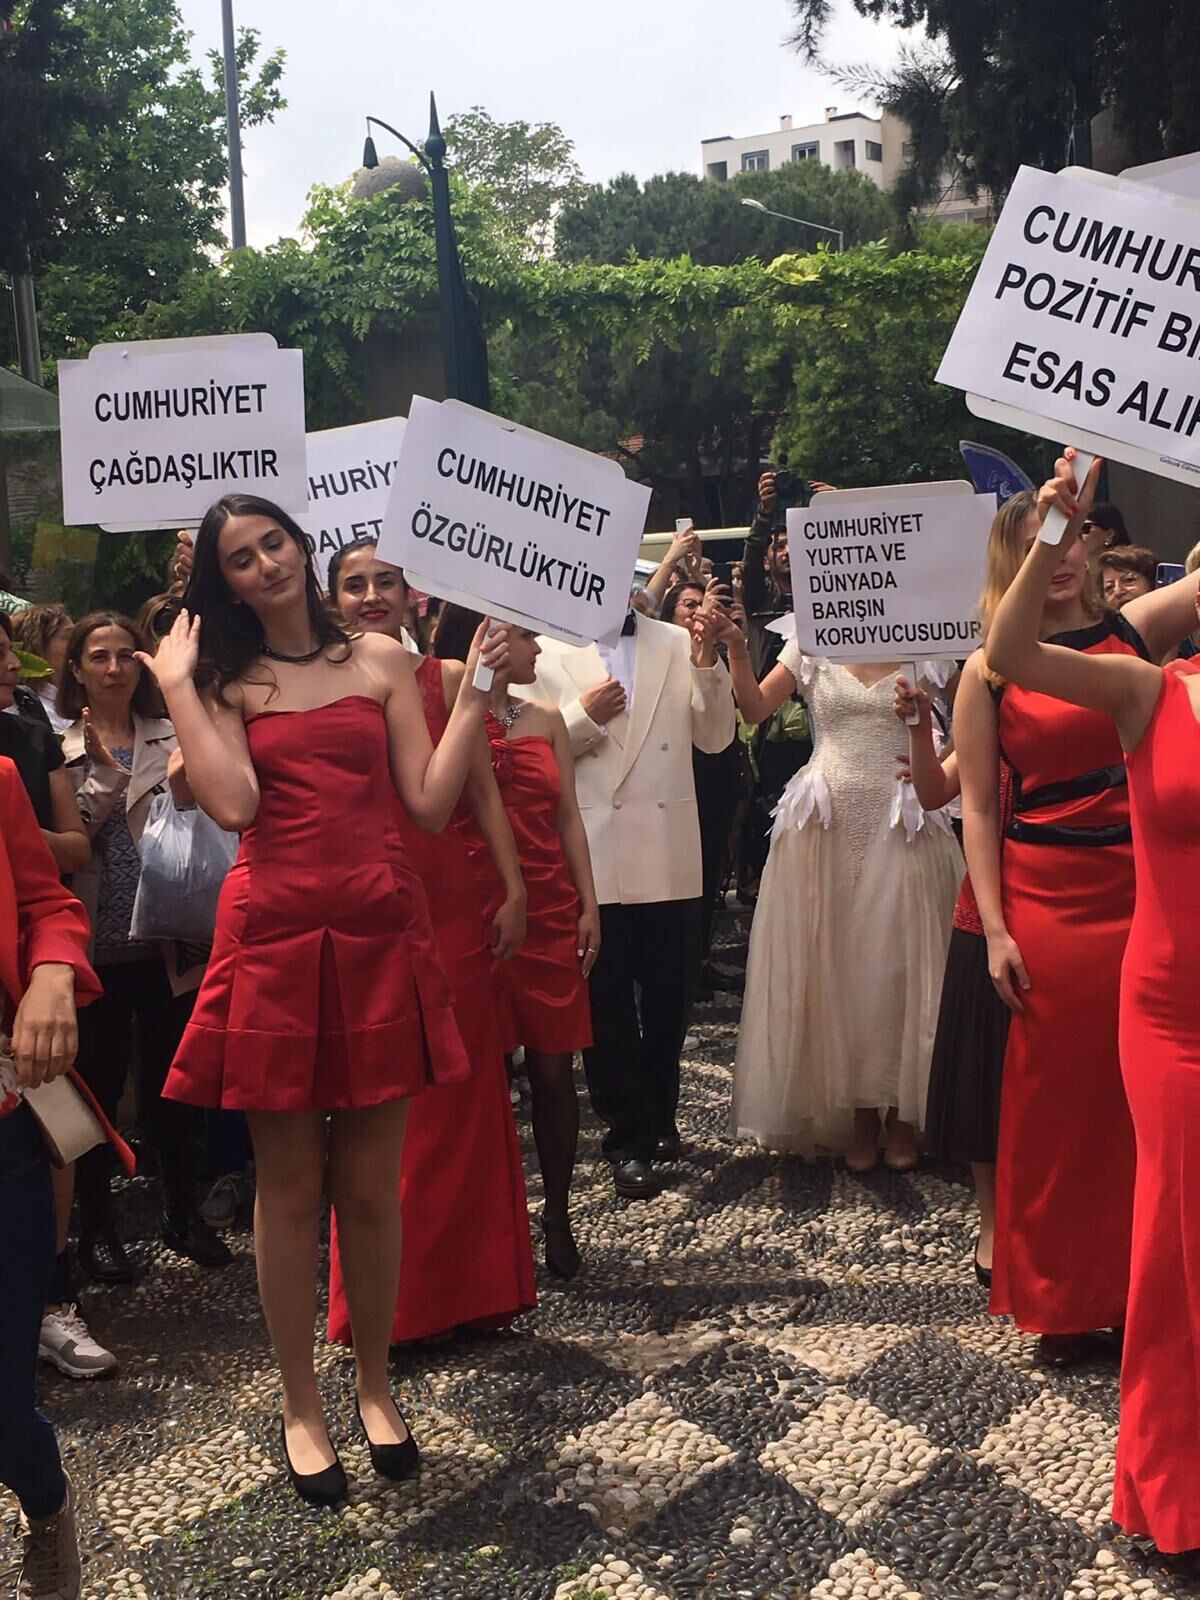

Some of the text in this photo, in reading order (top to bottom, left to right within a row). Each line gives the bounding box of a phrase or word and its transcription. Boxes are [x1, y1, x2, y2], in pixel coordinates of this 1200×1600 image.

[1024, 205, 1200, 293] CUMHUR
[995, 263, 1156, 338] POZİTİF
[1003, 341, 1116, 407] ESAS
[94, 379, 267, 422] CUMHURİYET
[90, 449, 279, 493] ÇAĞDAŞLIKTIR
[308, 460, 398, 501] HURİY
[437, 447, 611, 537] CUMHURİYET
[804, 511, 923, 540] CUMHURİYET
[411, 502, 606, 606] ÖZGÜRLÜKTÜR
[806, 542, 906, 567] YURTTA VE
[809, 570, 897, 593] DÜNYADA
[812, 599, 885, 622] BARIŞIN
[815, 620, 982, 646] KORUYUCUSUDUR
